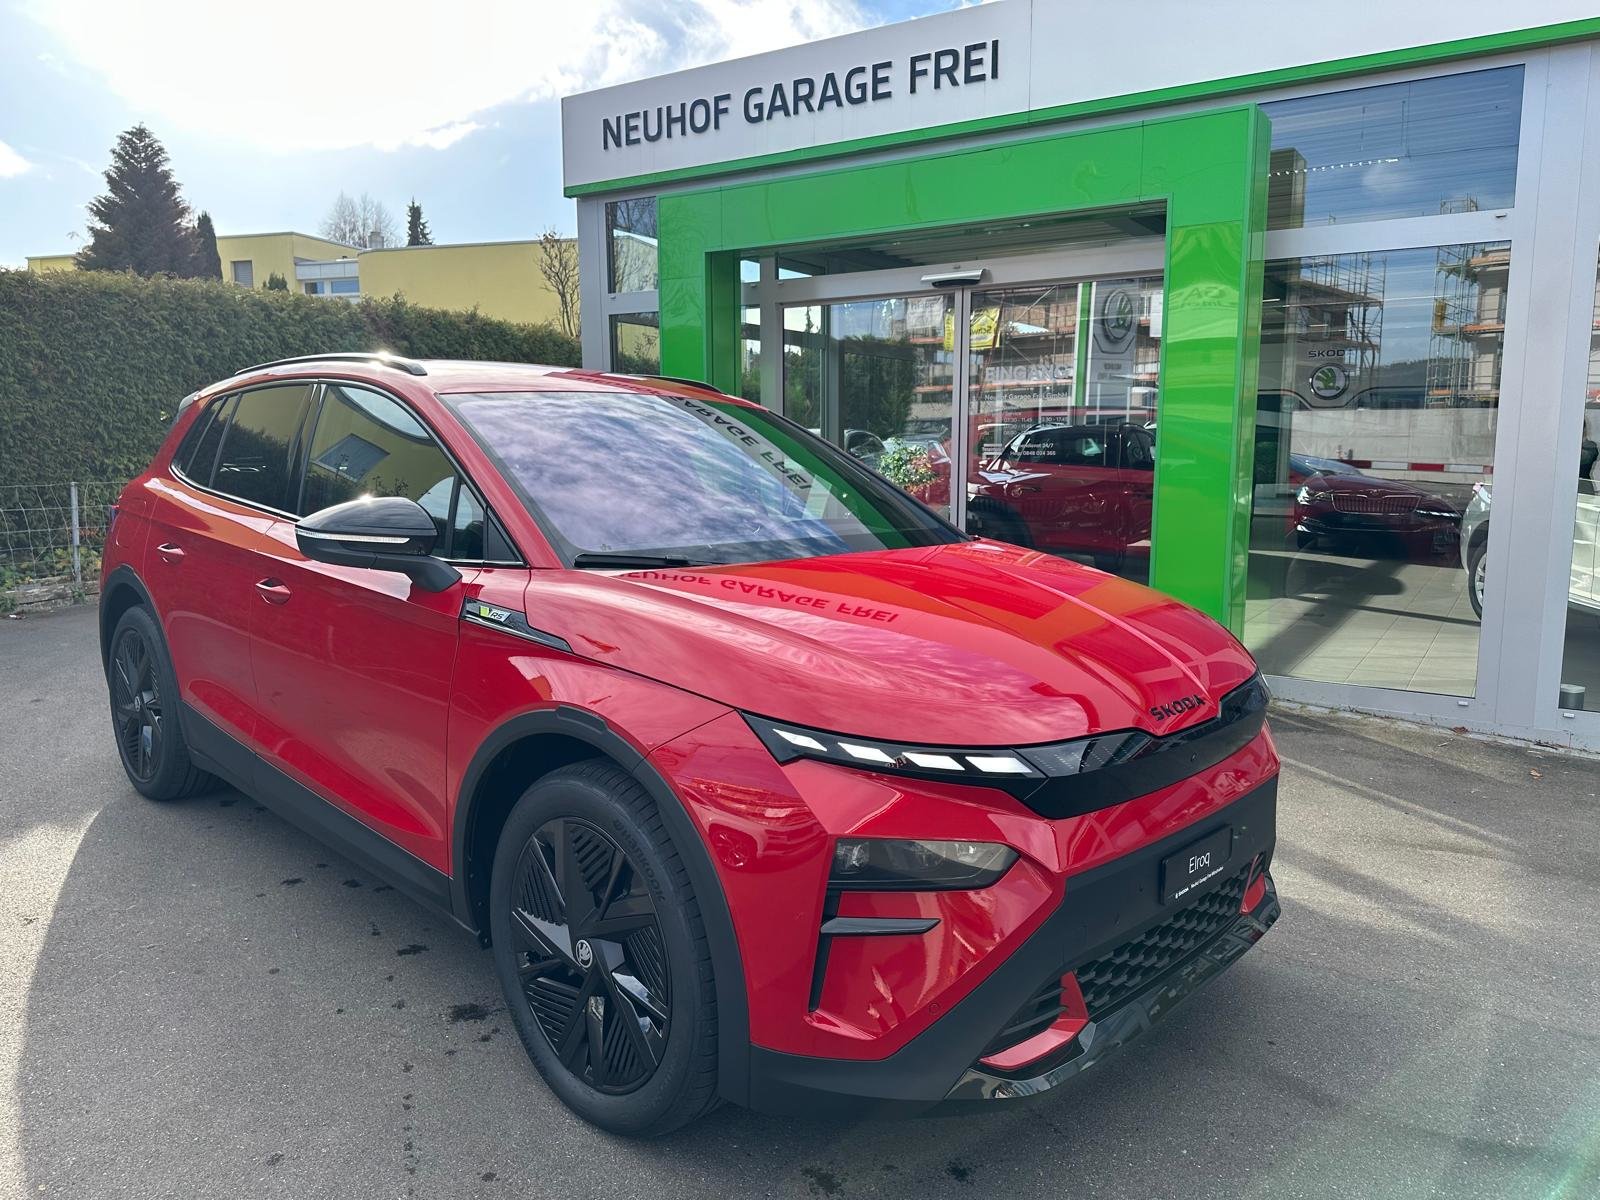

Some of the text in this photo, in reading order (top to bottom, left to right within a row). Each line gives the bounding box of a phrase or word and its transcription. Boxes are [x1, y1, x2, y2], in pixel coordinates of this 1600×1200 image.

[602, 39, 1000, 151] NEUHOF GARAGE FREI
[1308, 350, 1345, 358] SKOD
[1188, 852, 1211, 874] Elroq
